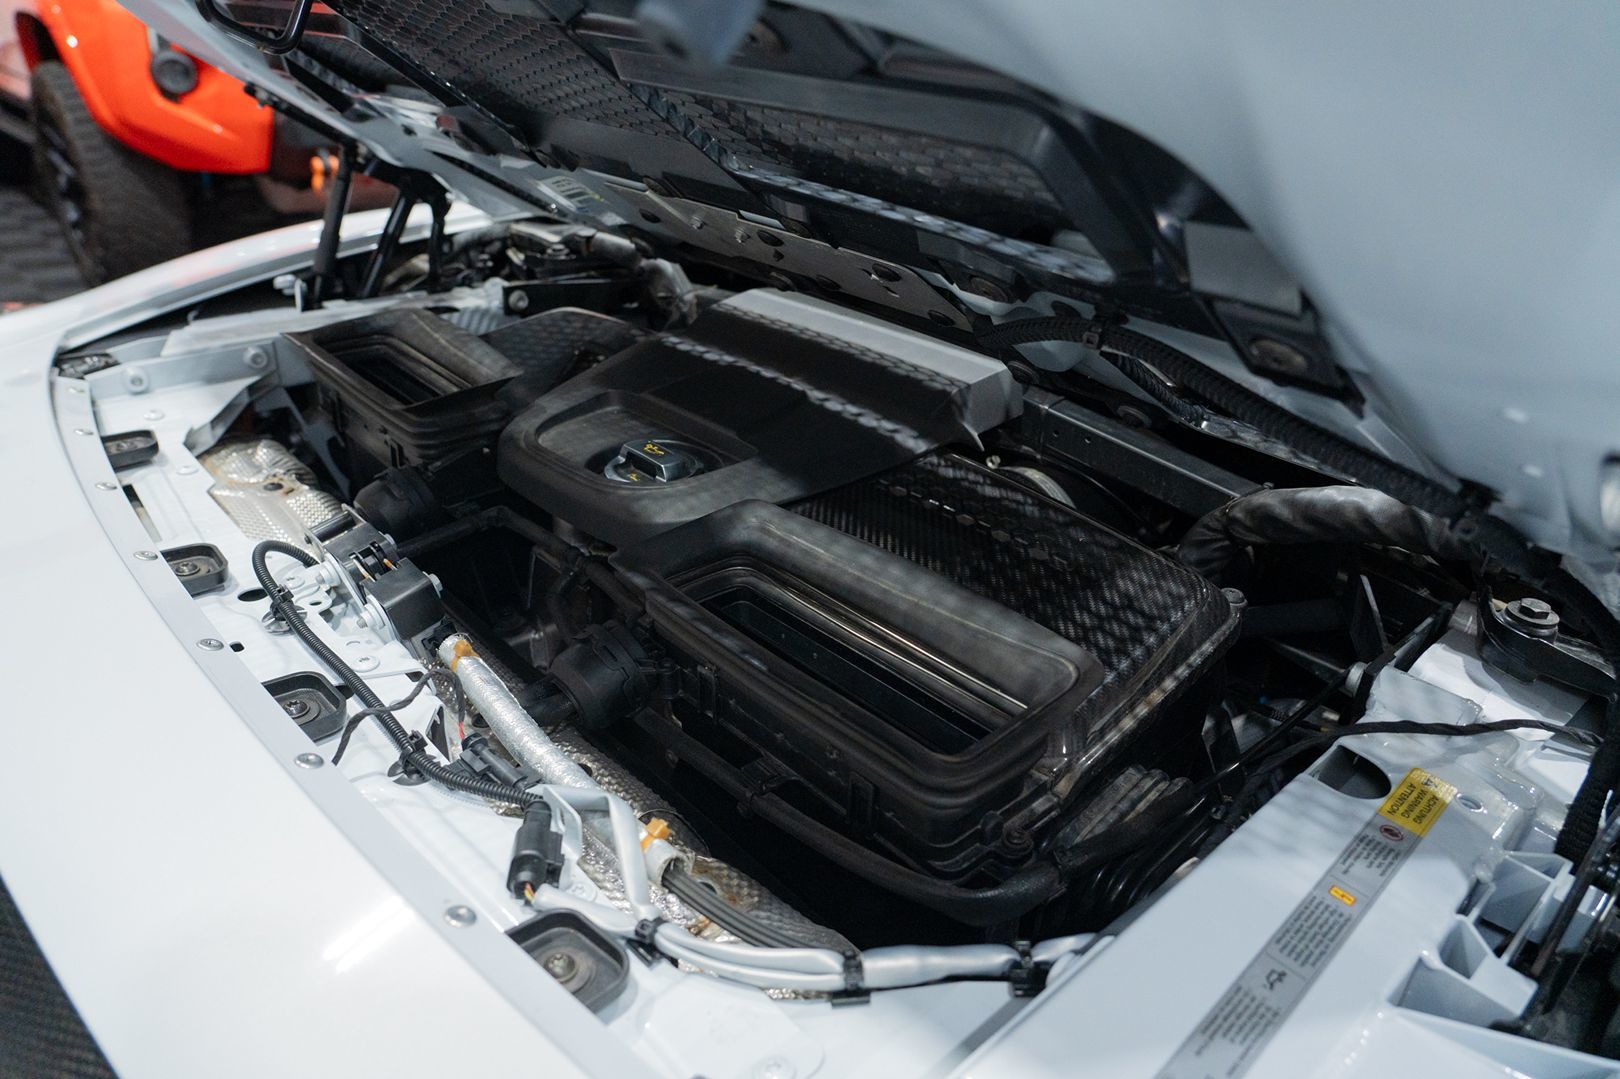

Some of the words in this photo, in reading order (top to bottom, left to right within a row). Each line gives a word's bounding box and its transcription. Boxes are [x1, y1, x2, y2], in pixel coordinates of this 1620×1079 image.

[1387, 783, 1416, 816] ATTENTION
[1401, 788, 1428, 818] WARNING
[1413, 795, 1439, 824] ACHTUNG
